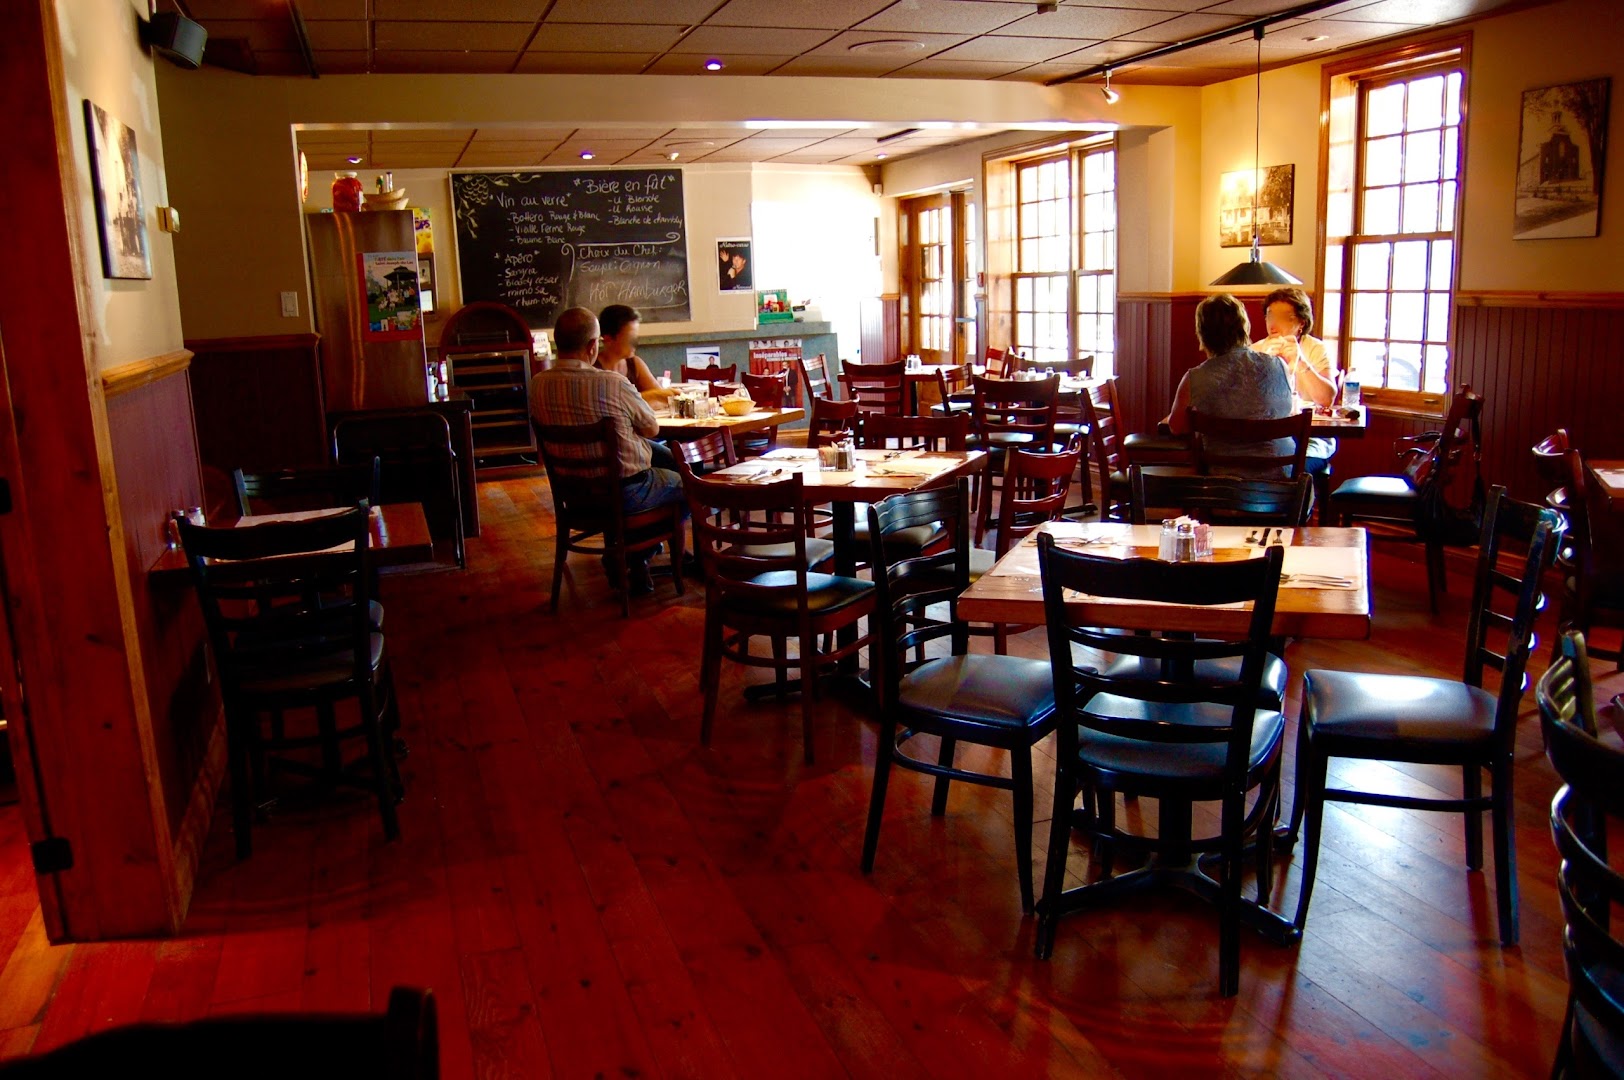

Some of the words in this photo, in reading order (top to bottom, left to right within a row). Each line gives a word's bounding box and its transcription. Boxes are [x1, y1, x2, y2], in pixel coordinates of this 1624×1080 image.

[582, 179, 620, 194] Bière
[625, 180, 640, 192] en
[645, 174, 666, 194] fût
[496, 192, 515, 208] Vin
[520, 196, 539, 206] au
[541, 195, 568, 207] verre
[549, 210, 570, 223] Rouge
[578, 211, 600, 221] Blanc
[643, 215, 652, 224] de
[567, 222, 586, 236] Rouge
[580, 246, 609, 259] Choix
[614, 246, 630, 256] du
[504, 253, 533, 266] Apéro
[505, 268, 538, 279] Sangria
